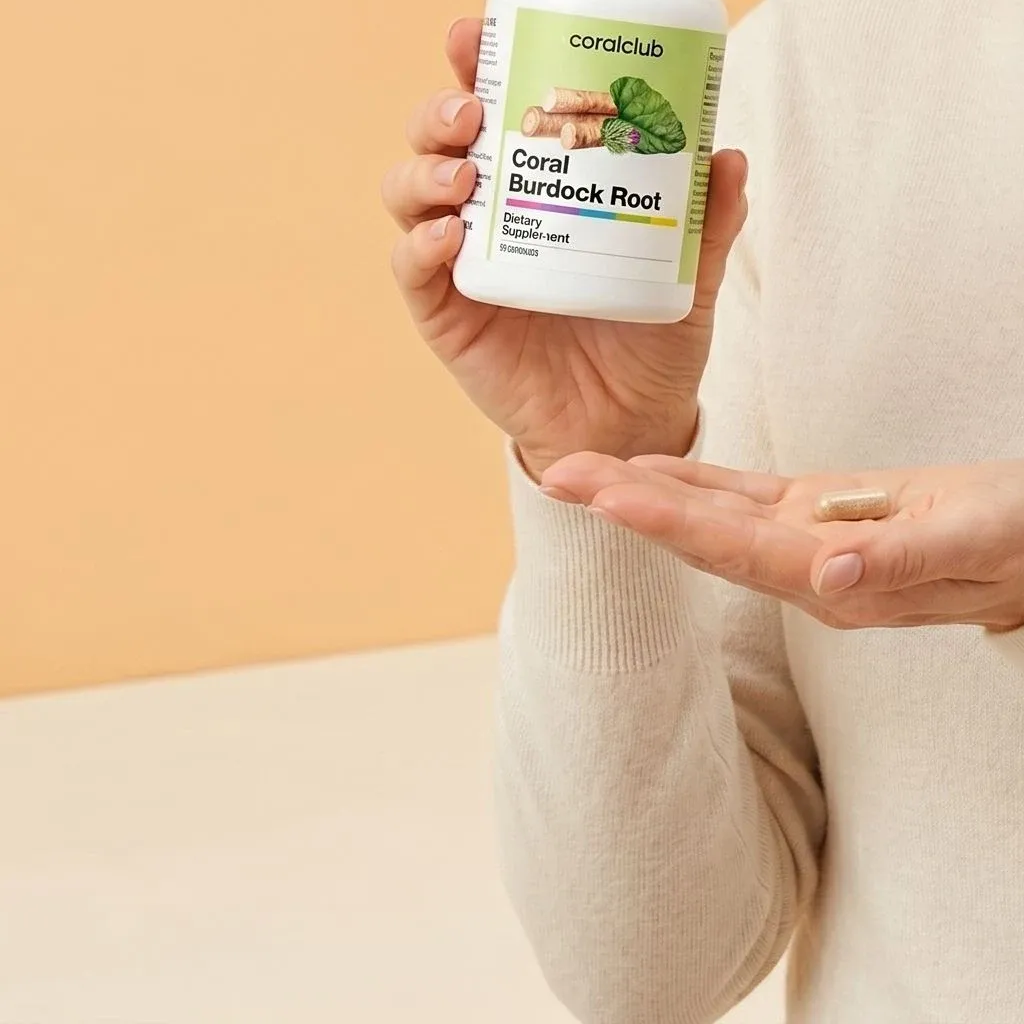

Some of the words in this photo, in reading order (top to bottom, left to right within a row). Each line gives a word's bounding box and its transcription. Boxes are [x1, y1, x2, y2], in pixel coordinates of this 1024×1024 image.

[569, 34, 664, 58] coralclub
[512, 148, 570, 174] Coral
[508, 173, 604, 204] Burdock
[610, 186, 662, 211] Root
[503, 212, 543, 229] Dietary
